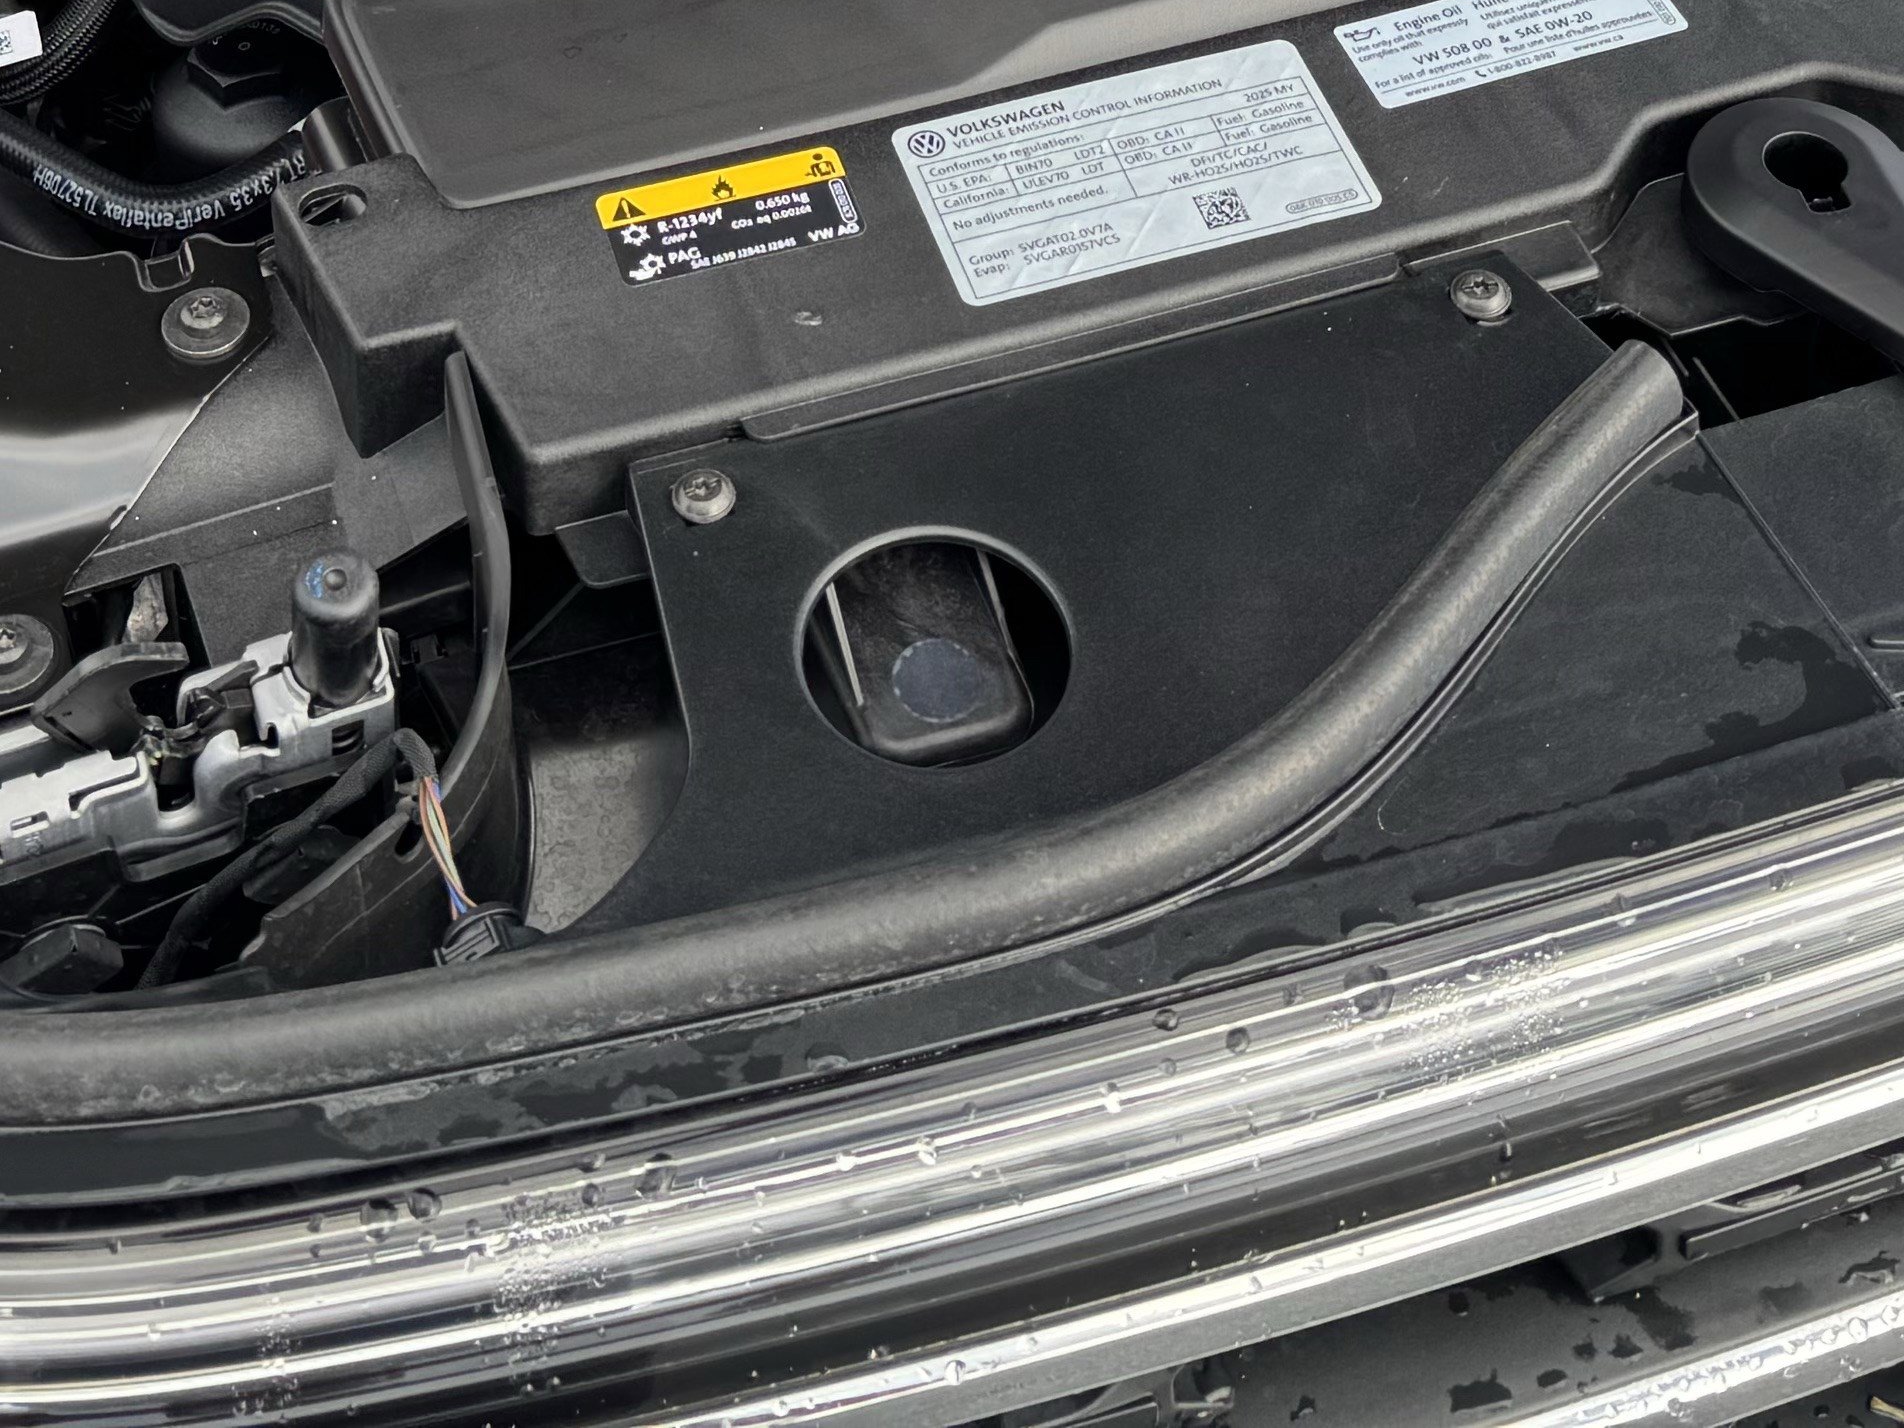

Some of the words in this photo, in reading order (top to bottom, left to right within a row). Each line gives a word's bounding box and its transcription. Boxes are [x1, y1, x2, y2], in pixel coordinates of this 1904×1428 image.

[1392, 11, 1443, 33] Engine
[1439, 5, 1463, 18] Oil
[1411, 50, 1442, 66] VW
[1440, 42, 1471, 57] 508
[1470, 36, 1494, 50] 00
[1496, 34, 1510, 43] &
[1513, 23, 1544, 38] SAE
[1542, 9, 1594, 31] 0W-20
[1373, 78, 1391, 88] For
[1425, 56, 1473, 75] approved
[1242, 88, 1273, 102] 2025
[1273, 82, 1295, 95] MY
[946, 100, 1066, 137] VOLKSWAGEN
[951, 129, 1006, 149] VEHICLE
[1007, 113, 1071, 136] EMISSION
[1071, 99, 1131, 120] CONTROL
[1132, 77, 1223, 106] INFORMATION
[927, 154, 991, 177] Conforms
[992, 150, 1008, 161] to
[1008, 131, 1087, 160] regulations:
[962, 172, 992, 187] EPA:
[1014, 157, 1054, 174] BIN70
[1072, 144, 1105, 160] LDT2
[1115, 134, 1150, 150] OBD:
[1153, 128, 1174, 141] CA
[1215, 112, 1247, 127] Fuel:
[1249, 98, 1305, 119] Gasoline
[941, 185, 1010, 209] California:
[1021, 170, 1070, 189] ULEV70
[1080, 162, 1106, 175] LDT
[1123, 149, 1157, 165] OBD:
[1161, 144, 1181, 156] CA
[1223, 127, 1255, 142] Fuel:
[1257, 113, 1313, 134] Gasoline
[753, 194, 791, 211] 0.650
[790, 189, 810, 205] kg
[951, 217, 973, 231] No
[972, 196, 1056, 227] adjustments
[1055, 183, 1109, 205] needed.
[655, 207, 725, 236] R-1234yf
[806, 226, 835, 242] VW
[834, 220, 860, 236] AG
[666, 246, 701, 264] PAG
[967, 245, 1015, 267] Group:
[973, 260, 1011, 278] Evap:
